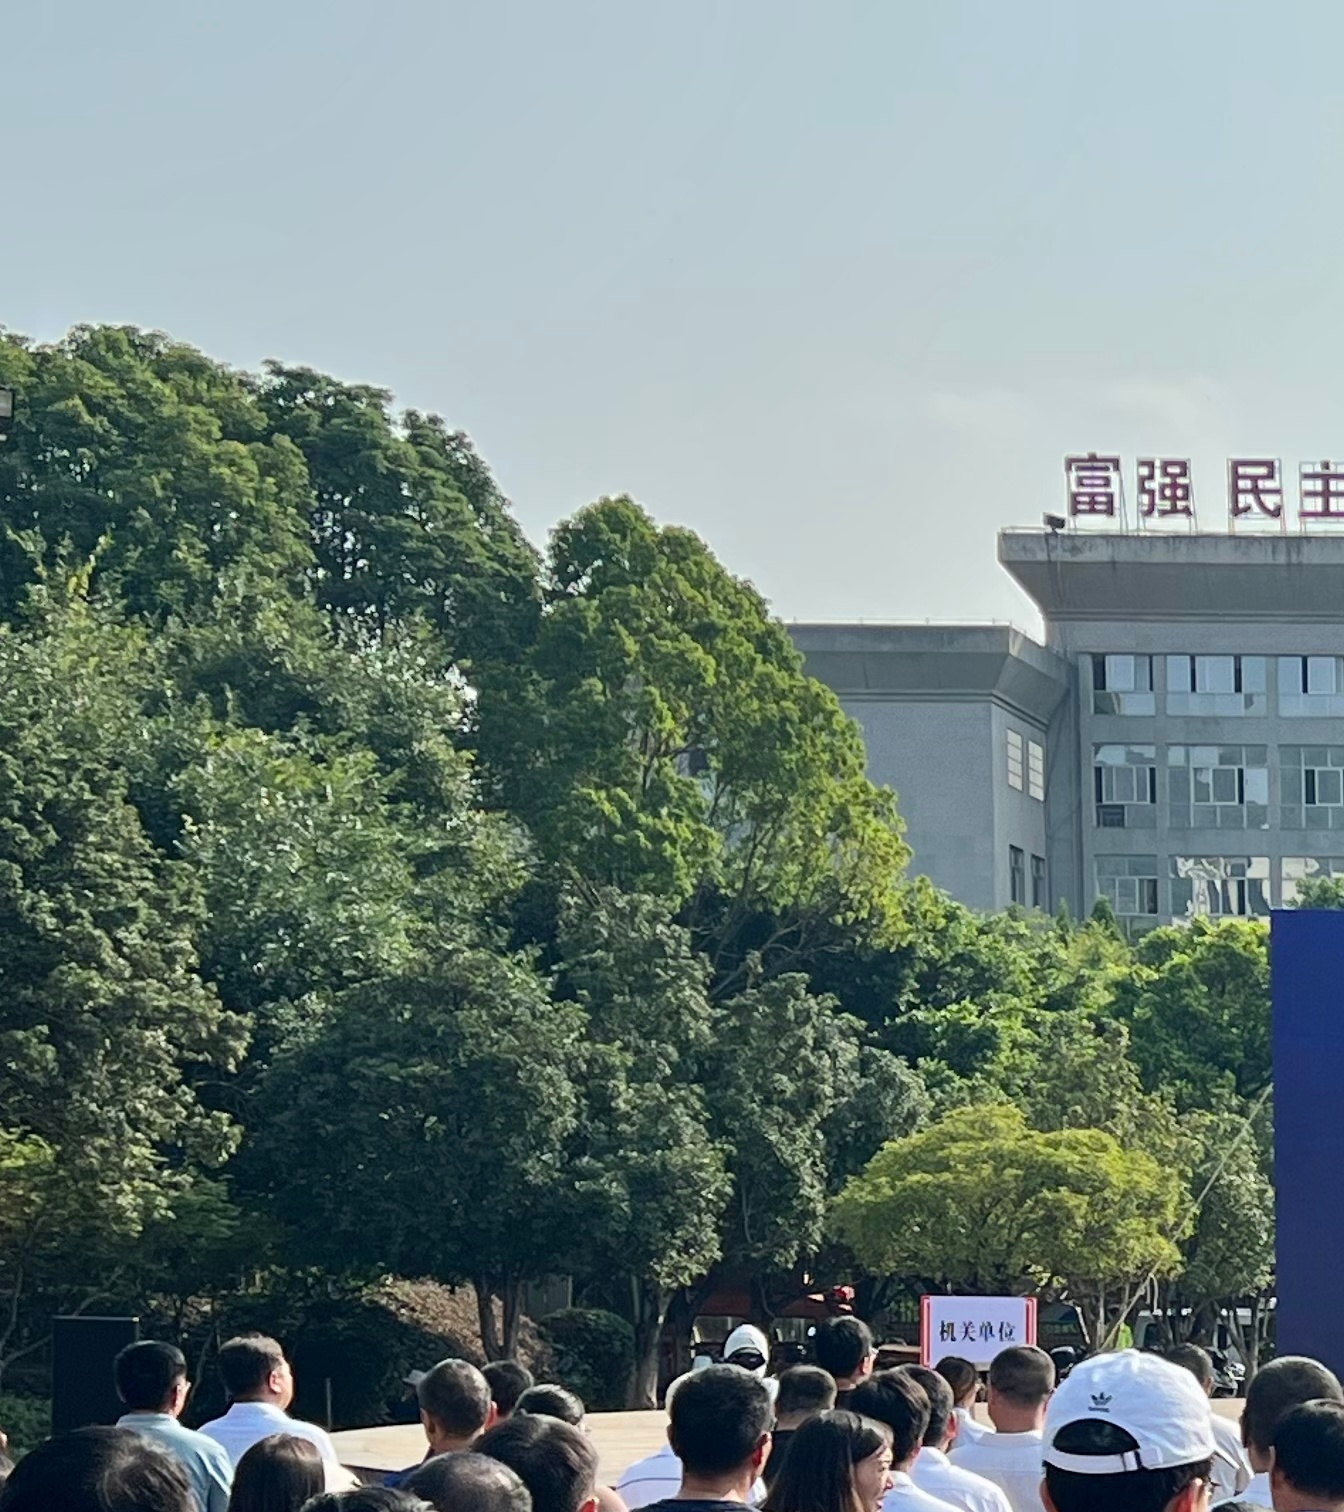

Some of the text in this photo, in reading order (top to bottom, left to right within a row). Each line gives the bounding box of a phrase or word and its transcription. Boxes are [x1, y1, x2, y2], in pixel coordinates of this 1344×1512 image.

[1064, 452, 1193, 518] 富强
[939, 1320, 1016, 1343] 机关单位
